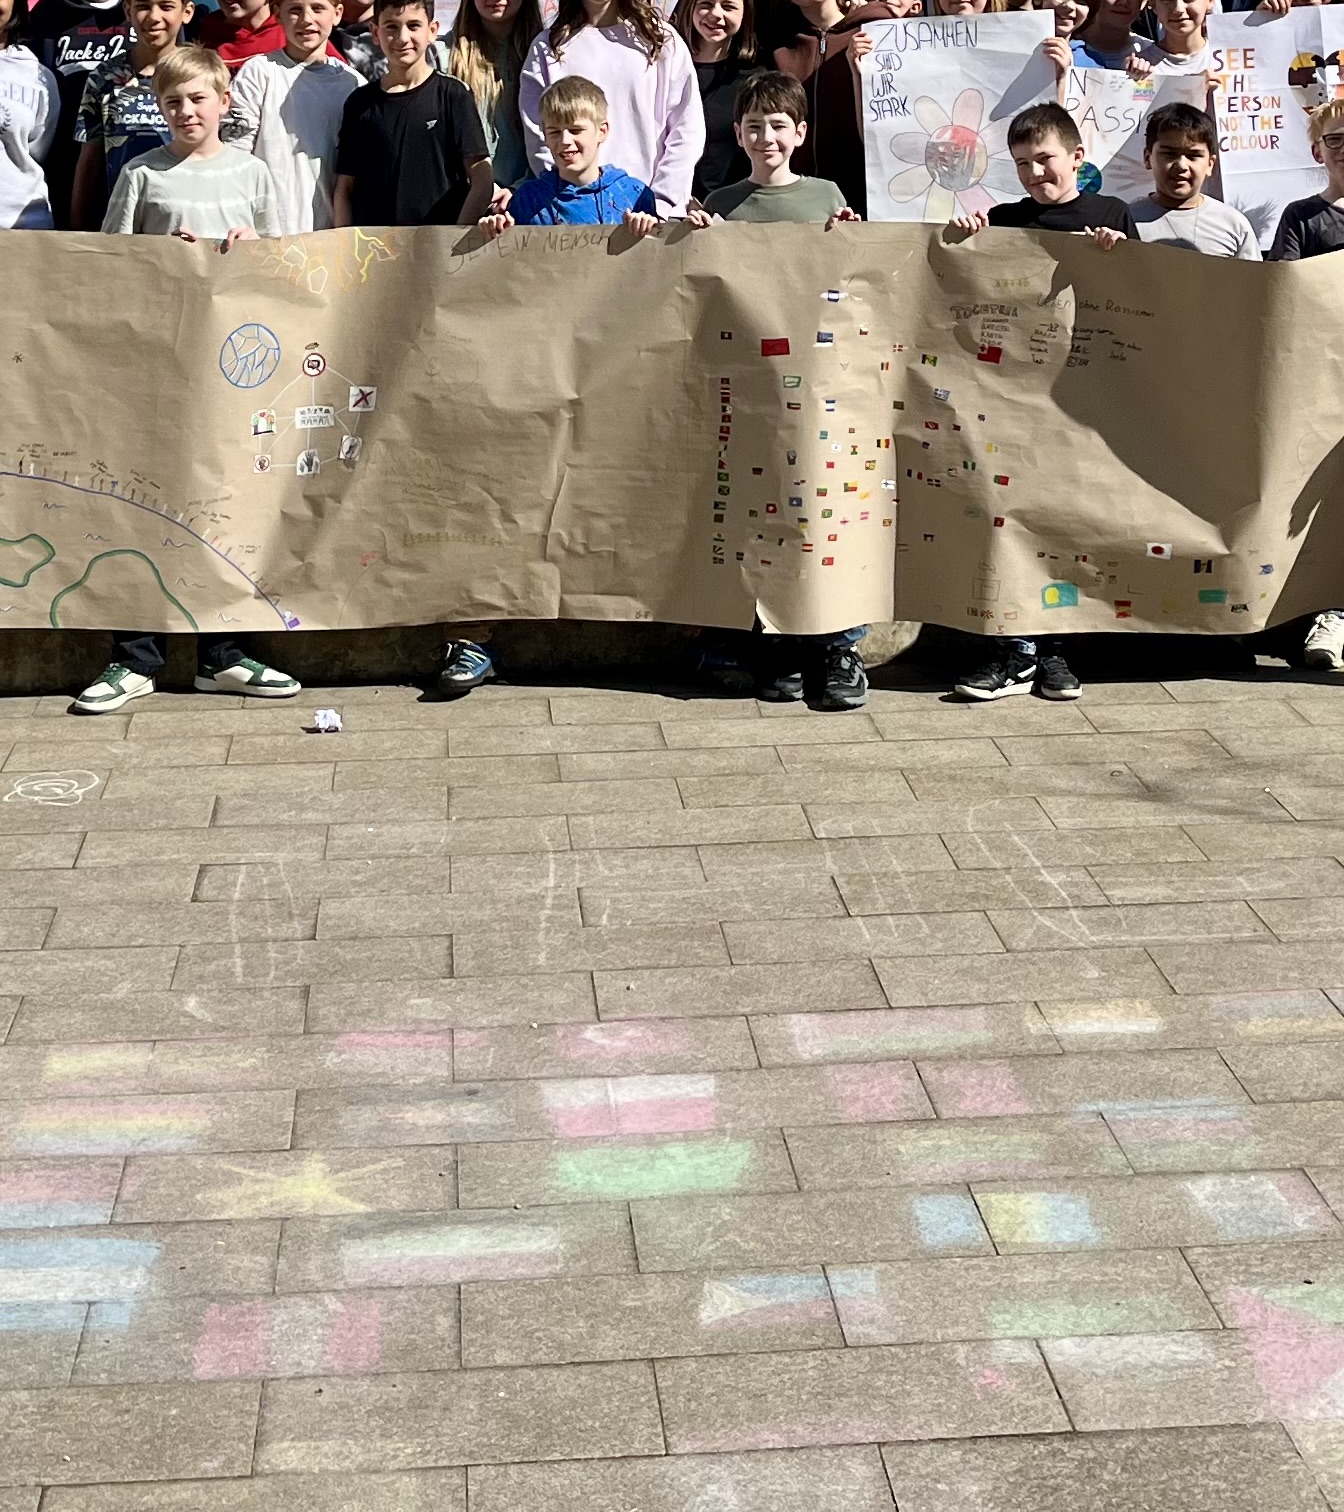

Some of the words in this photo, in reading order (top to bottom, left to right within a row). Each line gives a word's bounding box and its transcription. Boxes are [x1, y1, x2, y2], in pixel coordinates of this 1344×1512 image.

[873, 20, 978, 54] ZUSAMMEN
[875, 53, 903, 72] SIND
[1212, 48, 1256, 73] SEE
[871, 72, 897, 99] WIR
[1218, 74, 1259, 93] THE
[869, 95, 912, 122] STARK
[1216, 95, 1282, 113] PERSON
[1218, 116, 1244, 133] NOT
[1247, 114, 1284, 131] THE
[1218, 134, 1281, 153] COLOUR
